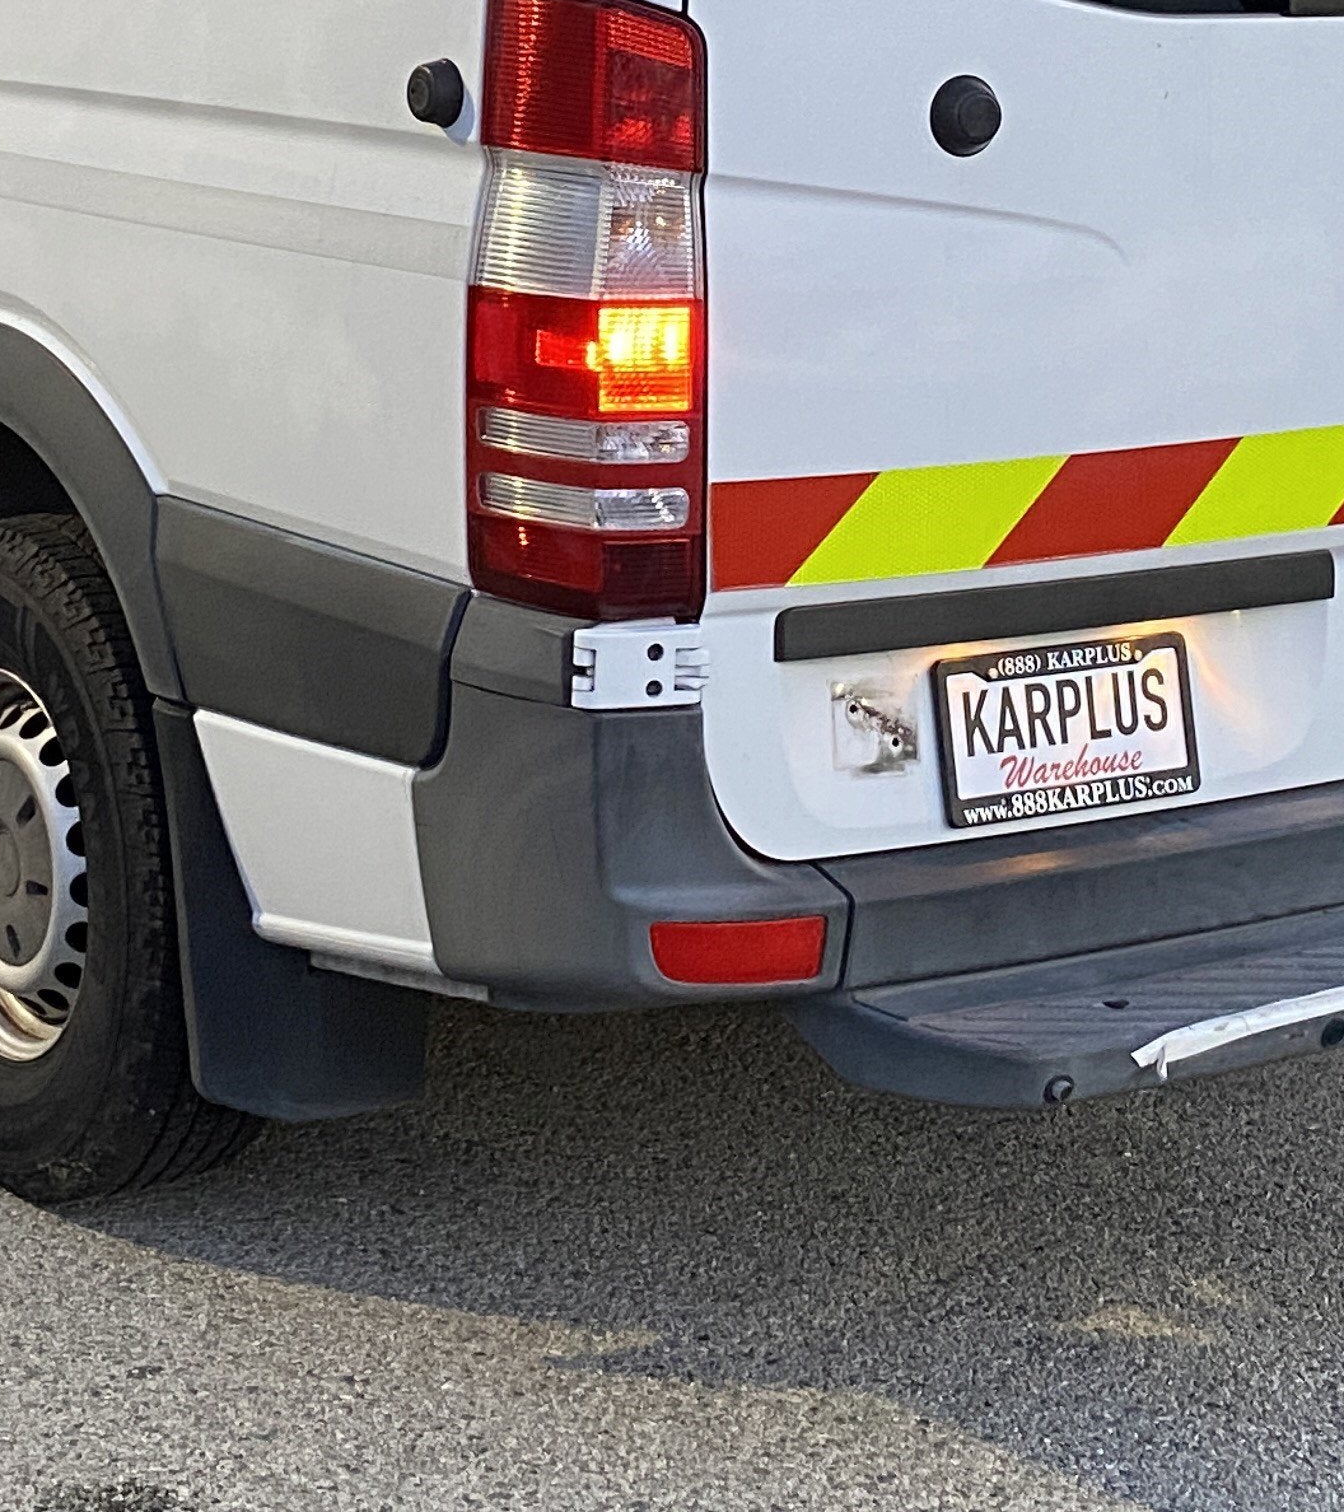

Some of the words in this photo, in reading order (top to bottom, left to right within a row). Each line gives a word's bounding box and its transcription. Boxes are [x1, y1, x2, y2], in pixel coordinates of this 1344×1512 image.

[997, 654, 1042, 678] (888)
[1047, 642, 1132, 671] KARPLUS
[962, 668, 1168, 757] KARPLUS
[999, 743, 1144, 789] Warehouse
